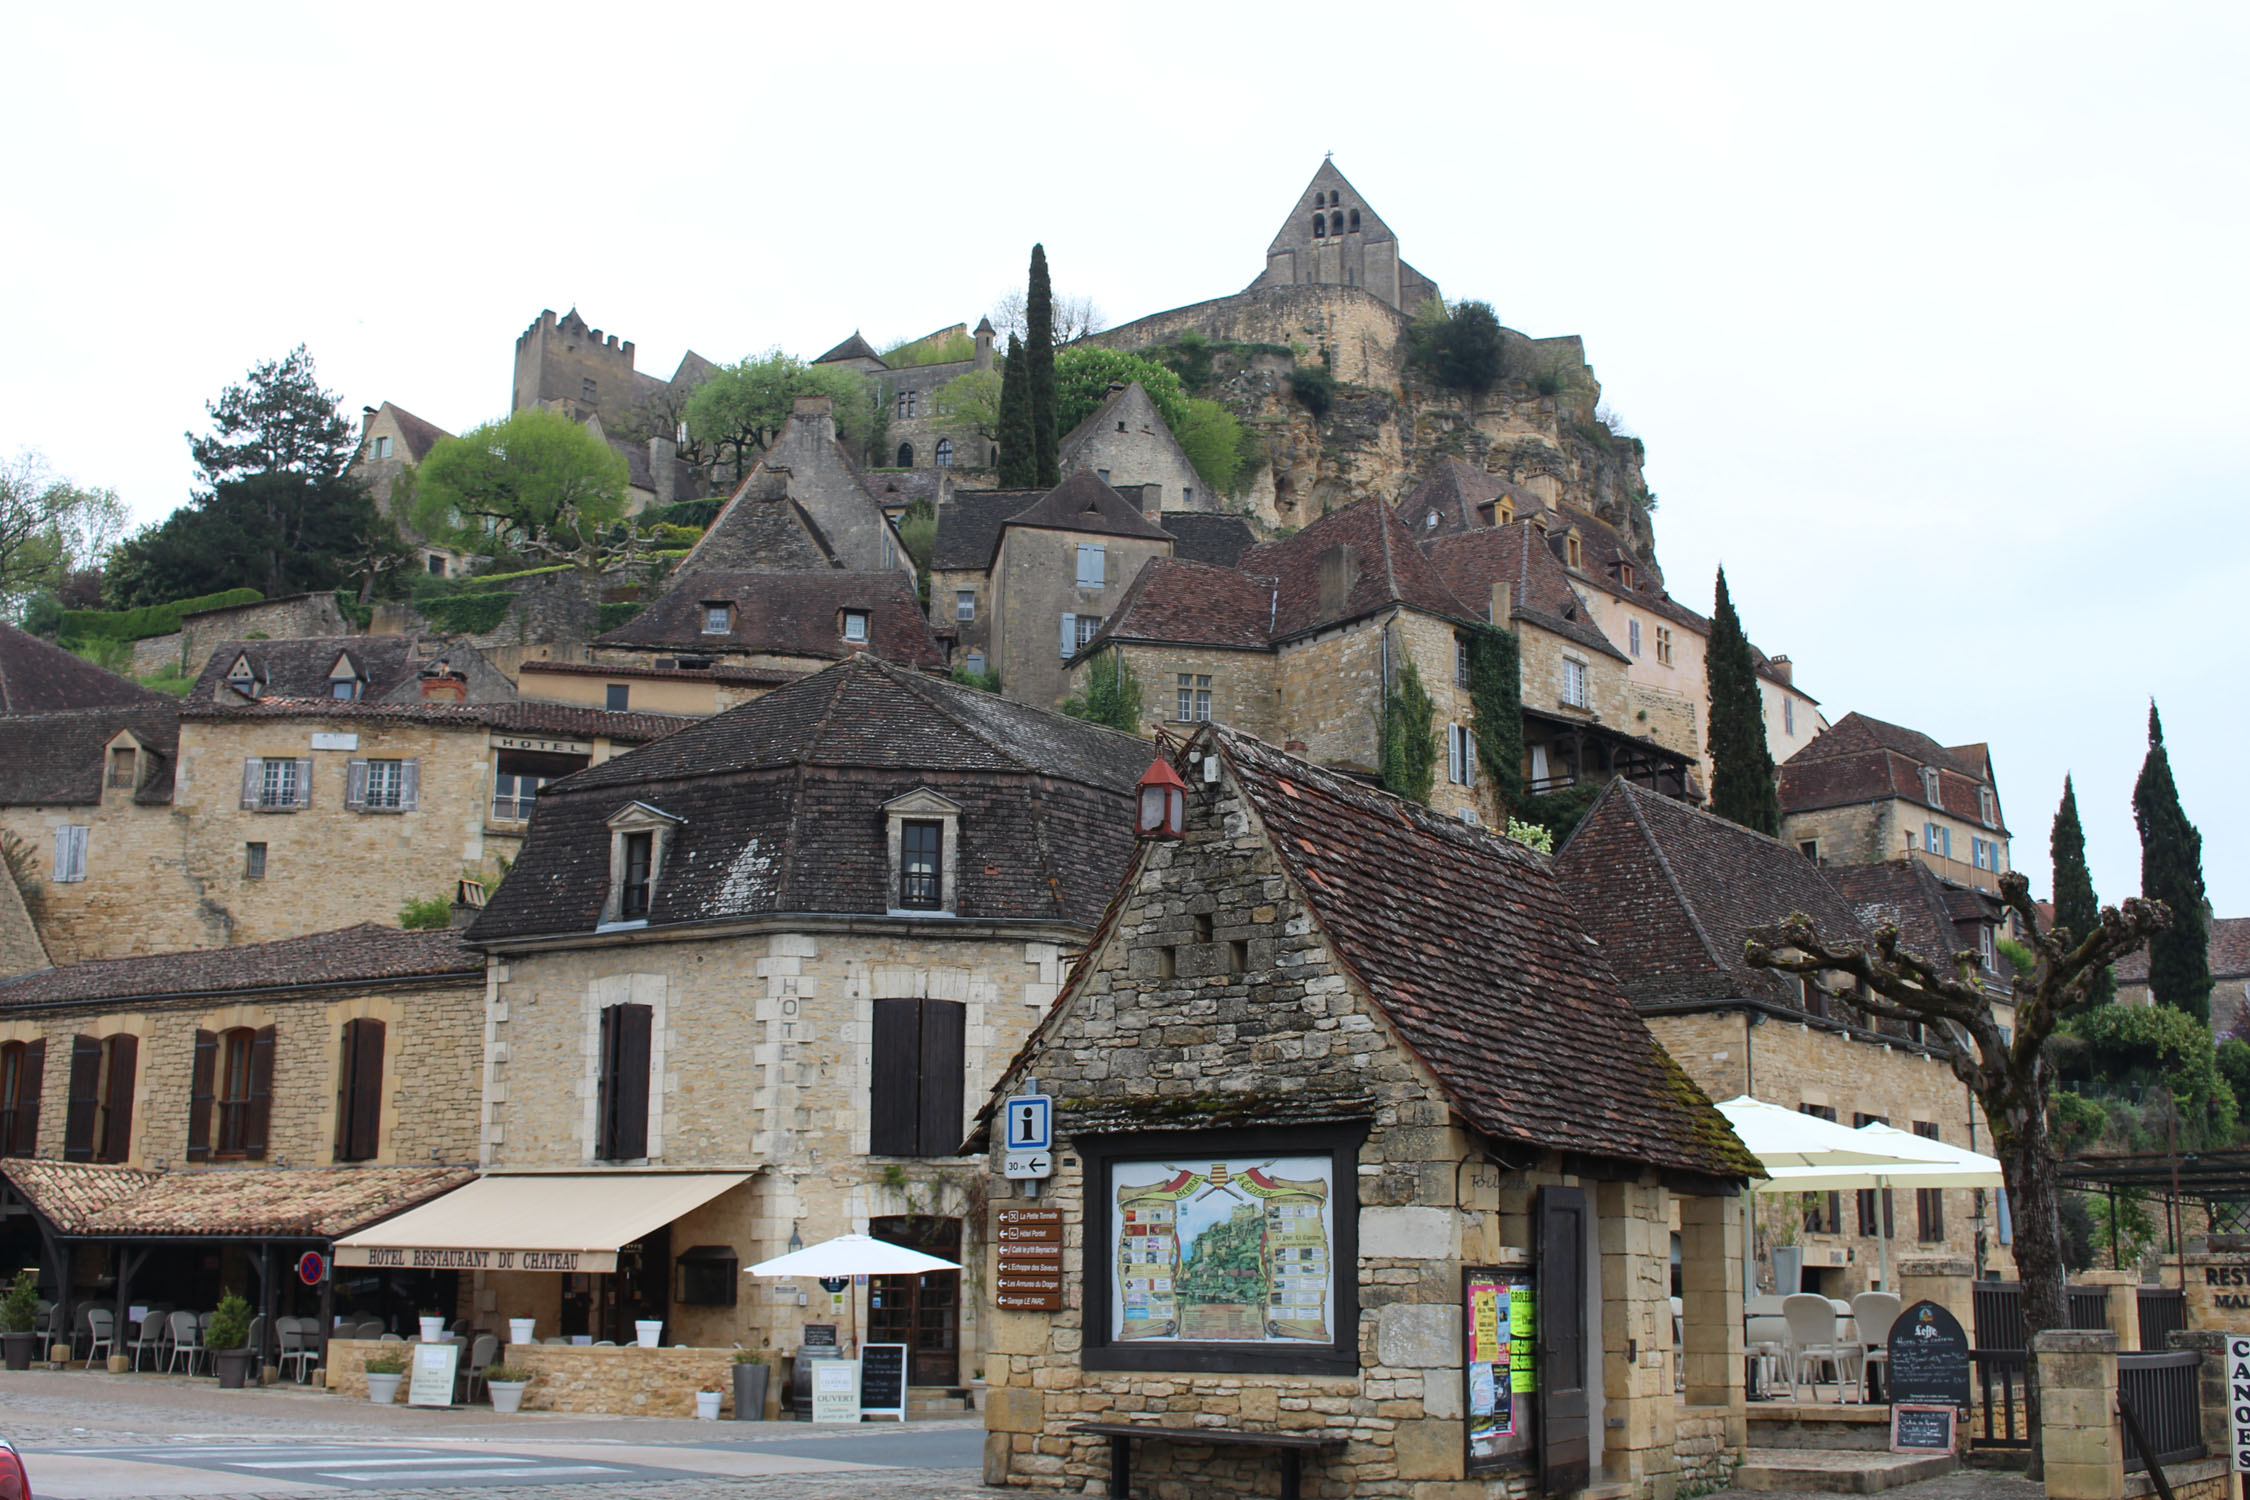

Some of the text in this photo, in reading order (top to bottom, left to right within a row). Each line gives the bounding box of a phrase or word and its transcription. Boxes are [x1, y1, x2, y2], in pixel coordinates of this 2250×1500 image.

[503, 739, 580, 753] HOTEL
[1008, 1162, 1019, 1171] 30
[413, 1250, 490, 1268] RESTAURANT
[498, 1252, 515, 1268] DU
[1914, 1324, 1938, 1338] Leffe
[817, 1394, 855, 1402] OUVERT
